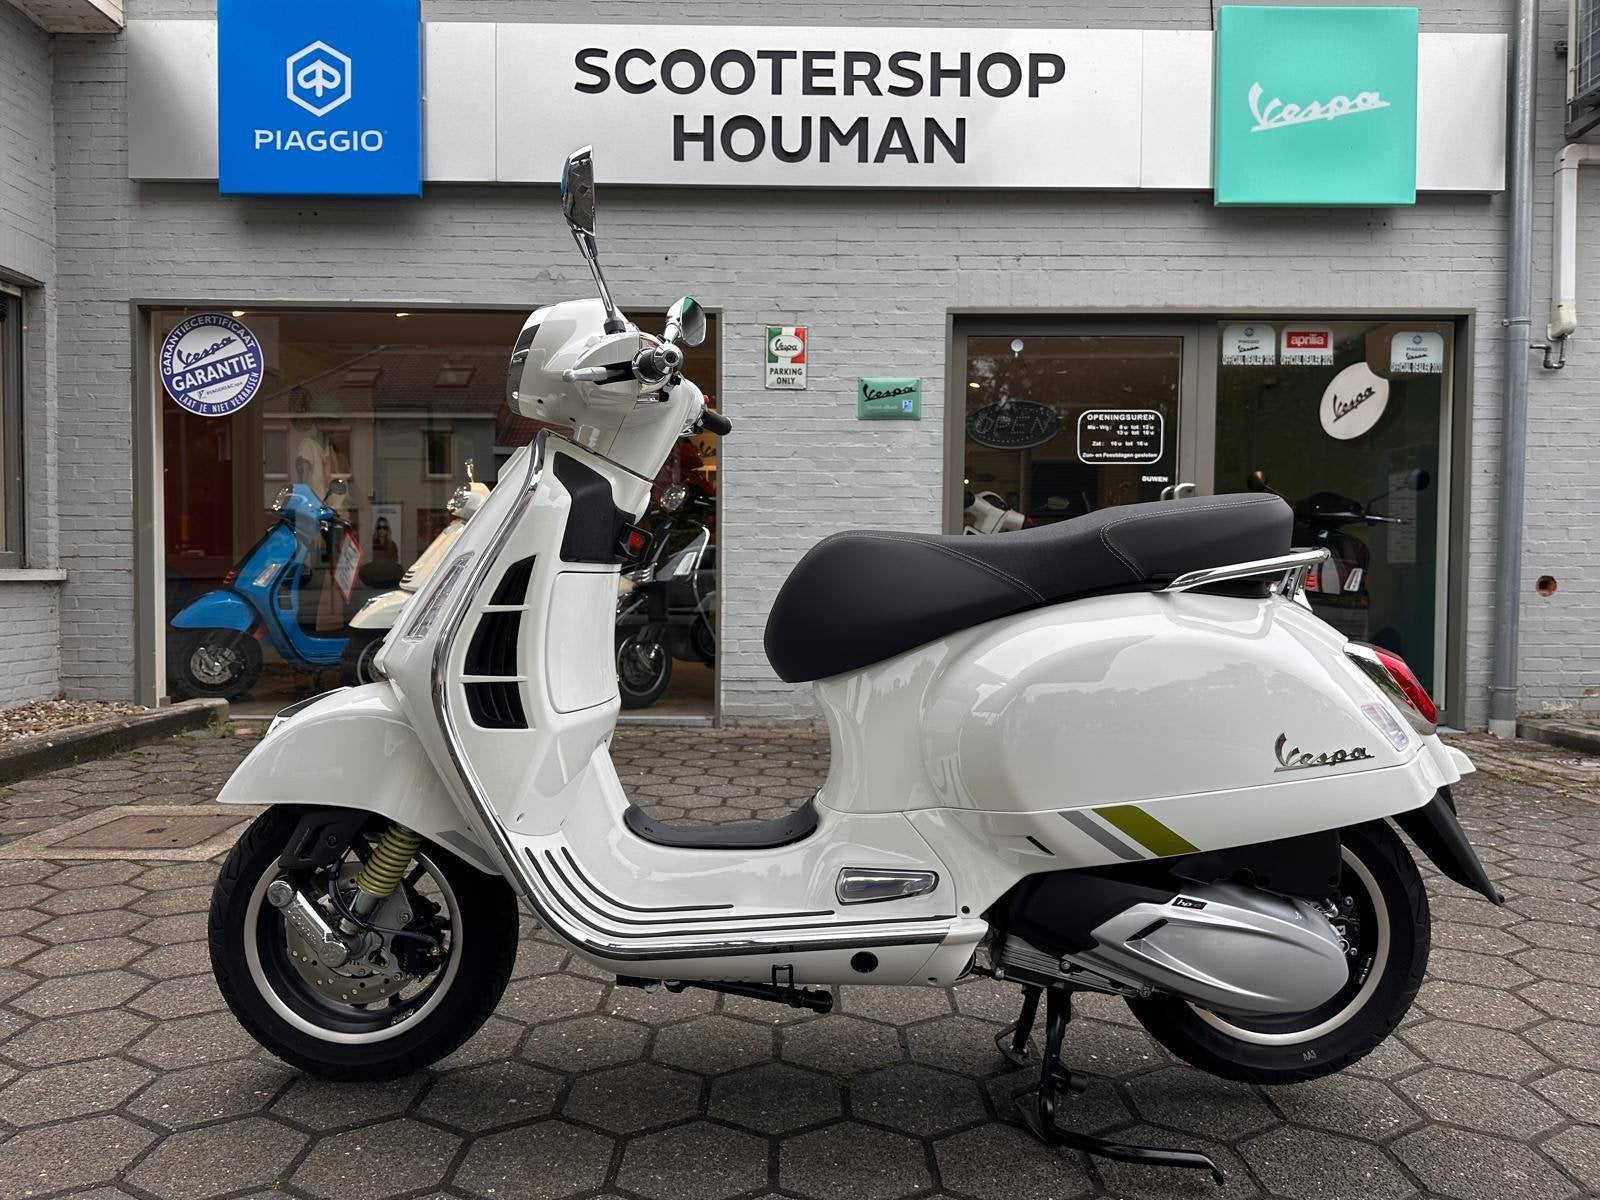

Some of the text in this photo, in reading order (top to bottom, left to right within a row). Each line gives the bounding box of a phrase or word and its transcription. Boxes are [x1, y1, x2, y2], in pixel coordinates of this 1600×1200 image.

[575, 48, 1066, 99] SCOOTERSHOP
[1248, 82, 1391, 132] Vespa
[254, 129, 384, 152] PIAGGIO
[673, 114, 966, 164] HOUMAN
[163, 315, 256, 376] GARANTIECERTIFICAAT
[177, 336, 238, 370] Vespa
[774, 338, 798, 352] Vespa
[1290, 334, 1324, 347] aprilia
[171, 353, 257, 392] GARANTIE
[769, 367, 803, 376] PARKING
[776, 377, 796, 385] ONLY
[178, 372, 260, 414] LAAT JE NIET VERRASSEN
[863, 383, 917, 402] Vespa
[1332, 386, 1376, 423] Vespa
[975, 415, 1052, 434] OPEN
[1086, 413, 1156, 421] OPENINGSUREN
[1141, 475, 1169, 483] DUWEN
[1273, 731, 1376, 773] Vespa
